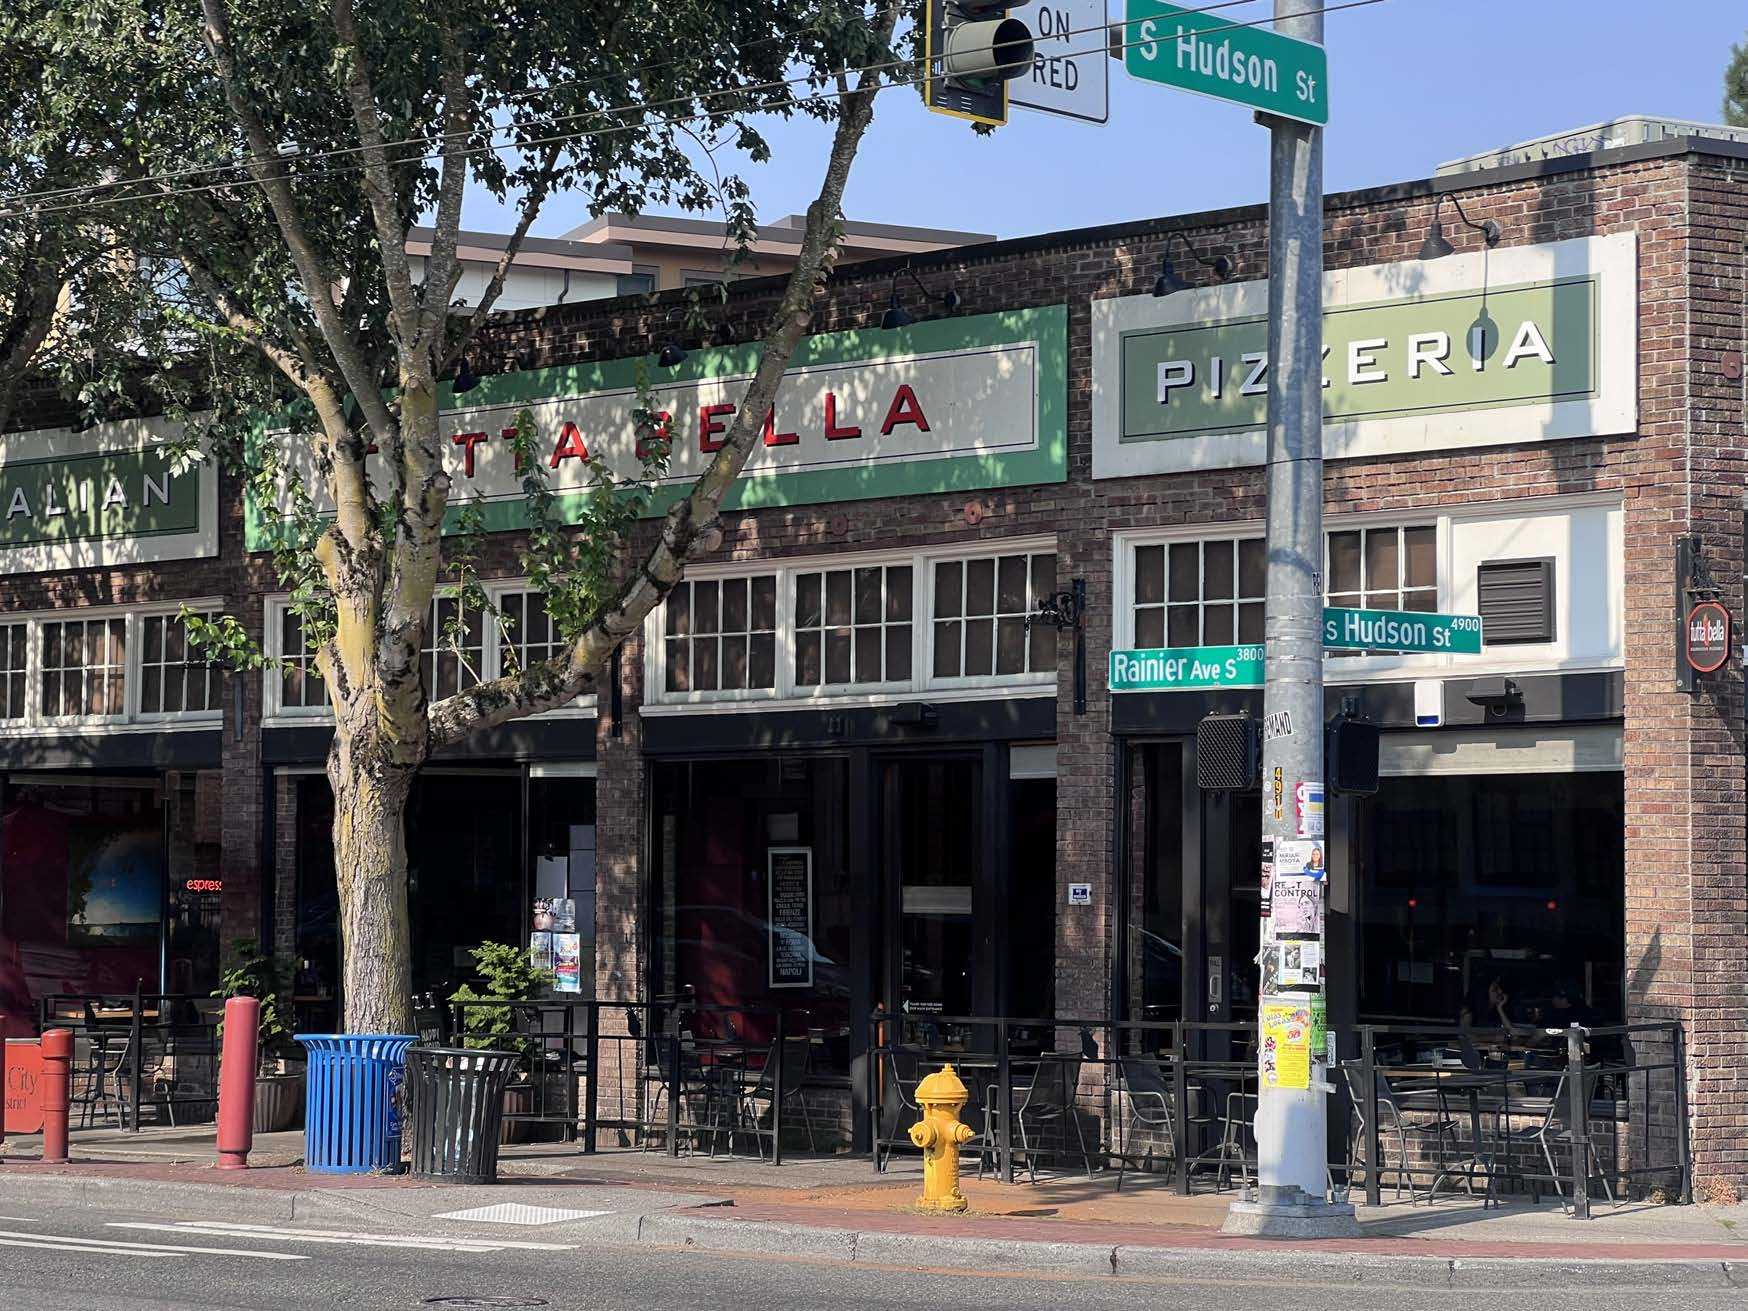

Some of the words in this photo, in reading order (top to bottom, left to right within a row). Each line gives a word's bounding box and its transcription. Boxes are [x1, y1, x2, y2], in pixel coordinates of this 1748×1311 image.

[1038, 6, 1070, 43] ON
[1033, 51, 1079, 91] RED
[1139, 20, 1158, 61] S
[1177, 25, 1278, 93] Hudson
[1296, 69, 1316, 103] St
[1157, 320, 1557, 405] PIZERIA
[1344, 612, 1426, 646] Hudson
[1432, 626, 1451, 647] St
[1450, 618, 1479, 632] 4900
[1707, 619, 1724, 641] bella
[1114, 652, 1187, 683] Rainier
[1189, 659, 1221, 681] Ave
[1224, 658, 1237, 680] S
[1236, 648, 1264, 661] 3800
[1274, 889, 1318, 898] CONTROL
[8, 1066, 39, 1096] City
